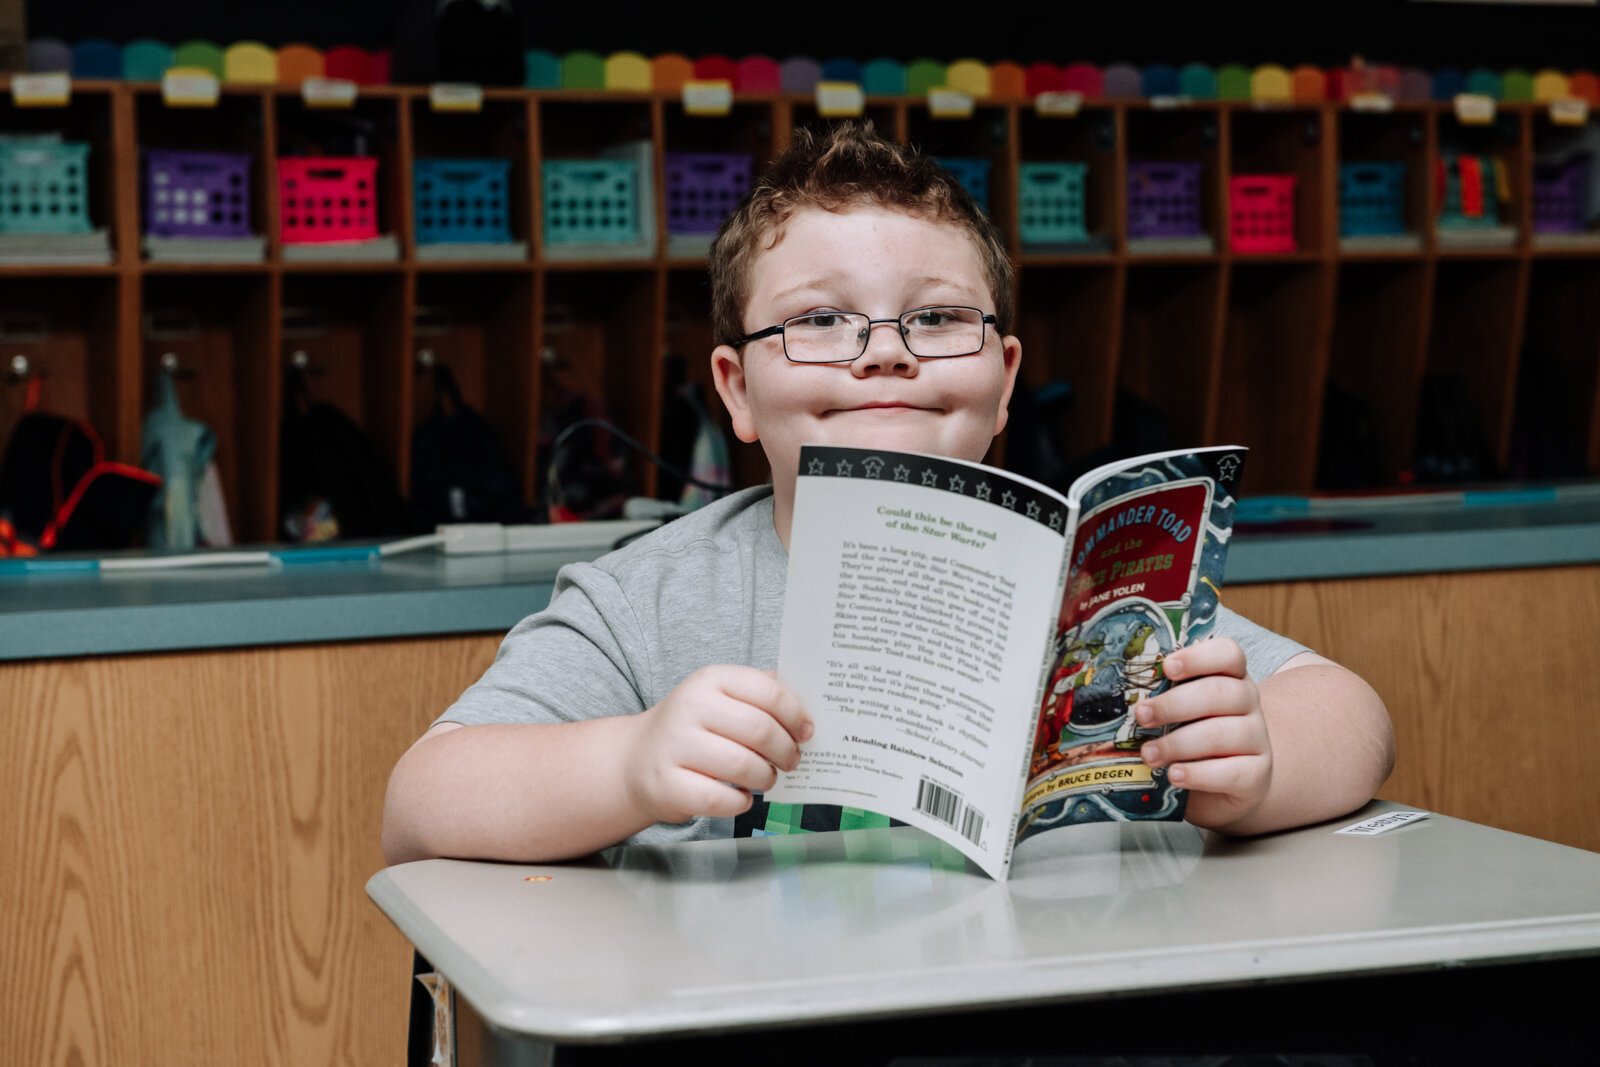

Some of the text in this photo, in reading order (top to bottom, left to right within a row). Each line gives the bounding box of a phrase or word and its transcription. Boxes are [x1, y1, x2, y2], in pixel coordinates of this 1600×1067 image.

[877, 506, 997, 541] Could this be the end
[886, 520, 986, 549] of the Star Warts?
[1071, 505, 1156, 577] COMMANDER
[1157, 508, 1192, 542] TOAD
[1124, 539, 1142, 550] the
[843, 541, 856, 549] It's
[859, 542, 879, 551] been
[890, 546, 908, 557] long
[932, 556, 947, 564] and
[949, 559, 996, 579] Commander
[999, 575, 1016, 589] Toad
[913, 561, 927, 569] the
[930, 565, 948, 574] Star
[952, 570, 974, 582] Warts
[1110, 554, 1174, 581] PIRATES
[840, 571, 853, 579] the
[892, 579, 908, 587] and
[912, 583, 930, 591] read
[933, 587, 944, 595] all
[947, 591, 959, 599] the
[963, 595, 984, 608] books
[999, 610, 1010, 620] the
[841, 561, 872, 570] They've
[876, 566, 904, 576] played
[922, 573, 935, 581] the
[970, 588, 1000, 605] watched
[1003, 602, 1013, 610] all
[1088, 590, 1111, 608] JANE
[1113, 582, 1145, 597] YOLEN
[859, 593, 882, 602] Warts
[895, 599, 917, 610] being
[920, 604, 953, 619] hijacked
[956, 614, 965, 624] by
[862, 584, 900, 596] Suddenly
[922, 595, 945, 606] alarm
[948, 603, 966, 612] goes
[968, 609, 979, 617] off
[981, 615, 995, 624] and
[997, 621, 1009, 630] the
[849, 602, 899, 615] Commander
[994, 642, 1005, 651] the
[915, 624, 928, 632] the
[832, 641, 882, 653] Commander
[885, 647, 904, 657] Toad
[906, 653, 921, 661] and
[923, 657, 935, 665] his
[937, 663, 954, 671] crew
[852, 633, 888, 644] hostages
[894, 640, 912, 650] play
[939, 652, 952, 660] the
[986, 670, 1000, 682] Can
[880, 629, 898, 637] very
[927, 639, 941, 647] and
[944, 642, 953, 650] he
[955, 647, 973, 658] likes
[984, 660, 1002, 672] make
[846, 682, 865, 691] keep
[887, 690, 917, 701] readers
[864, 665, 881, 673] wild
[886, 669, 901, 677] and
[906, 674, 936, 687] raucous
[941, 685, 955, 694] and
[959, 692, 995, 713] sometimes
[873, 675, 886, 683] but
[904, 683, 919, 692] just
[923, 688, 943, 699] these
[946, 697, 977, 714] qualities
[979, 711, 993, 723] that
[857, 709, 878, 717] puns
[860, 700, 889, 710] writing
[907, 709, 922, 718] this
[927, 715, 943, 726] book
[851, 735, 888, 749] Reading
[890, 743, 927, 760] Rainbow
[928, 756, 964, 778] Selection
[932, 737, 958, 753] Library
[1046, 783, 1056, 791] by
[1058, 773, 1092, 788] BRUCE
[1094, 769, 1133, 781] DEGEN
